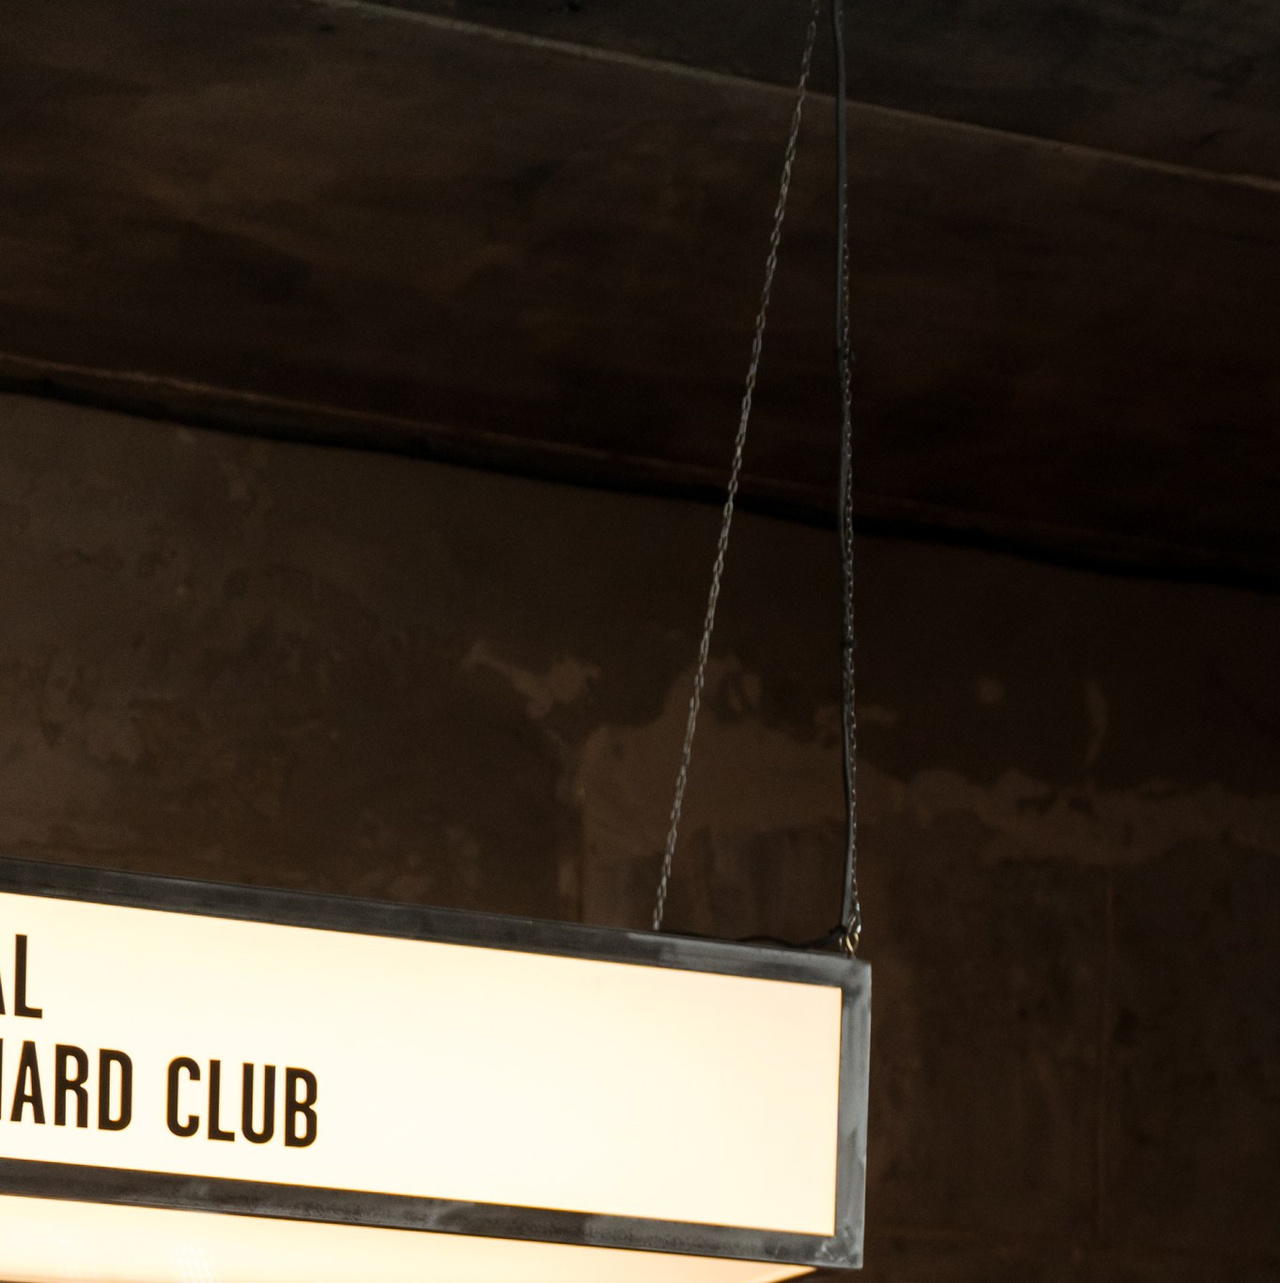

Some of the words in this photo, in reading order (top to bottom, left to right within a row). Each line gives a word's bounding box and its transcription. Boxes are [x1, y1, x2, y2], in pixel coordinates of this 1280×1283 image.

[0, 933, 43, 1020] L
[0, 1038, 133, 1131] ARD
[166, 1055, 318, 1148] CLUB
